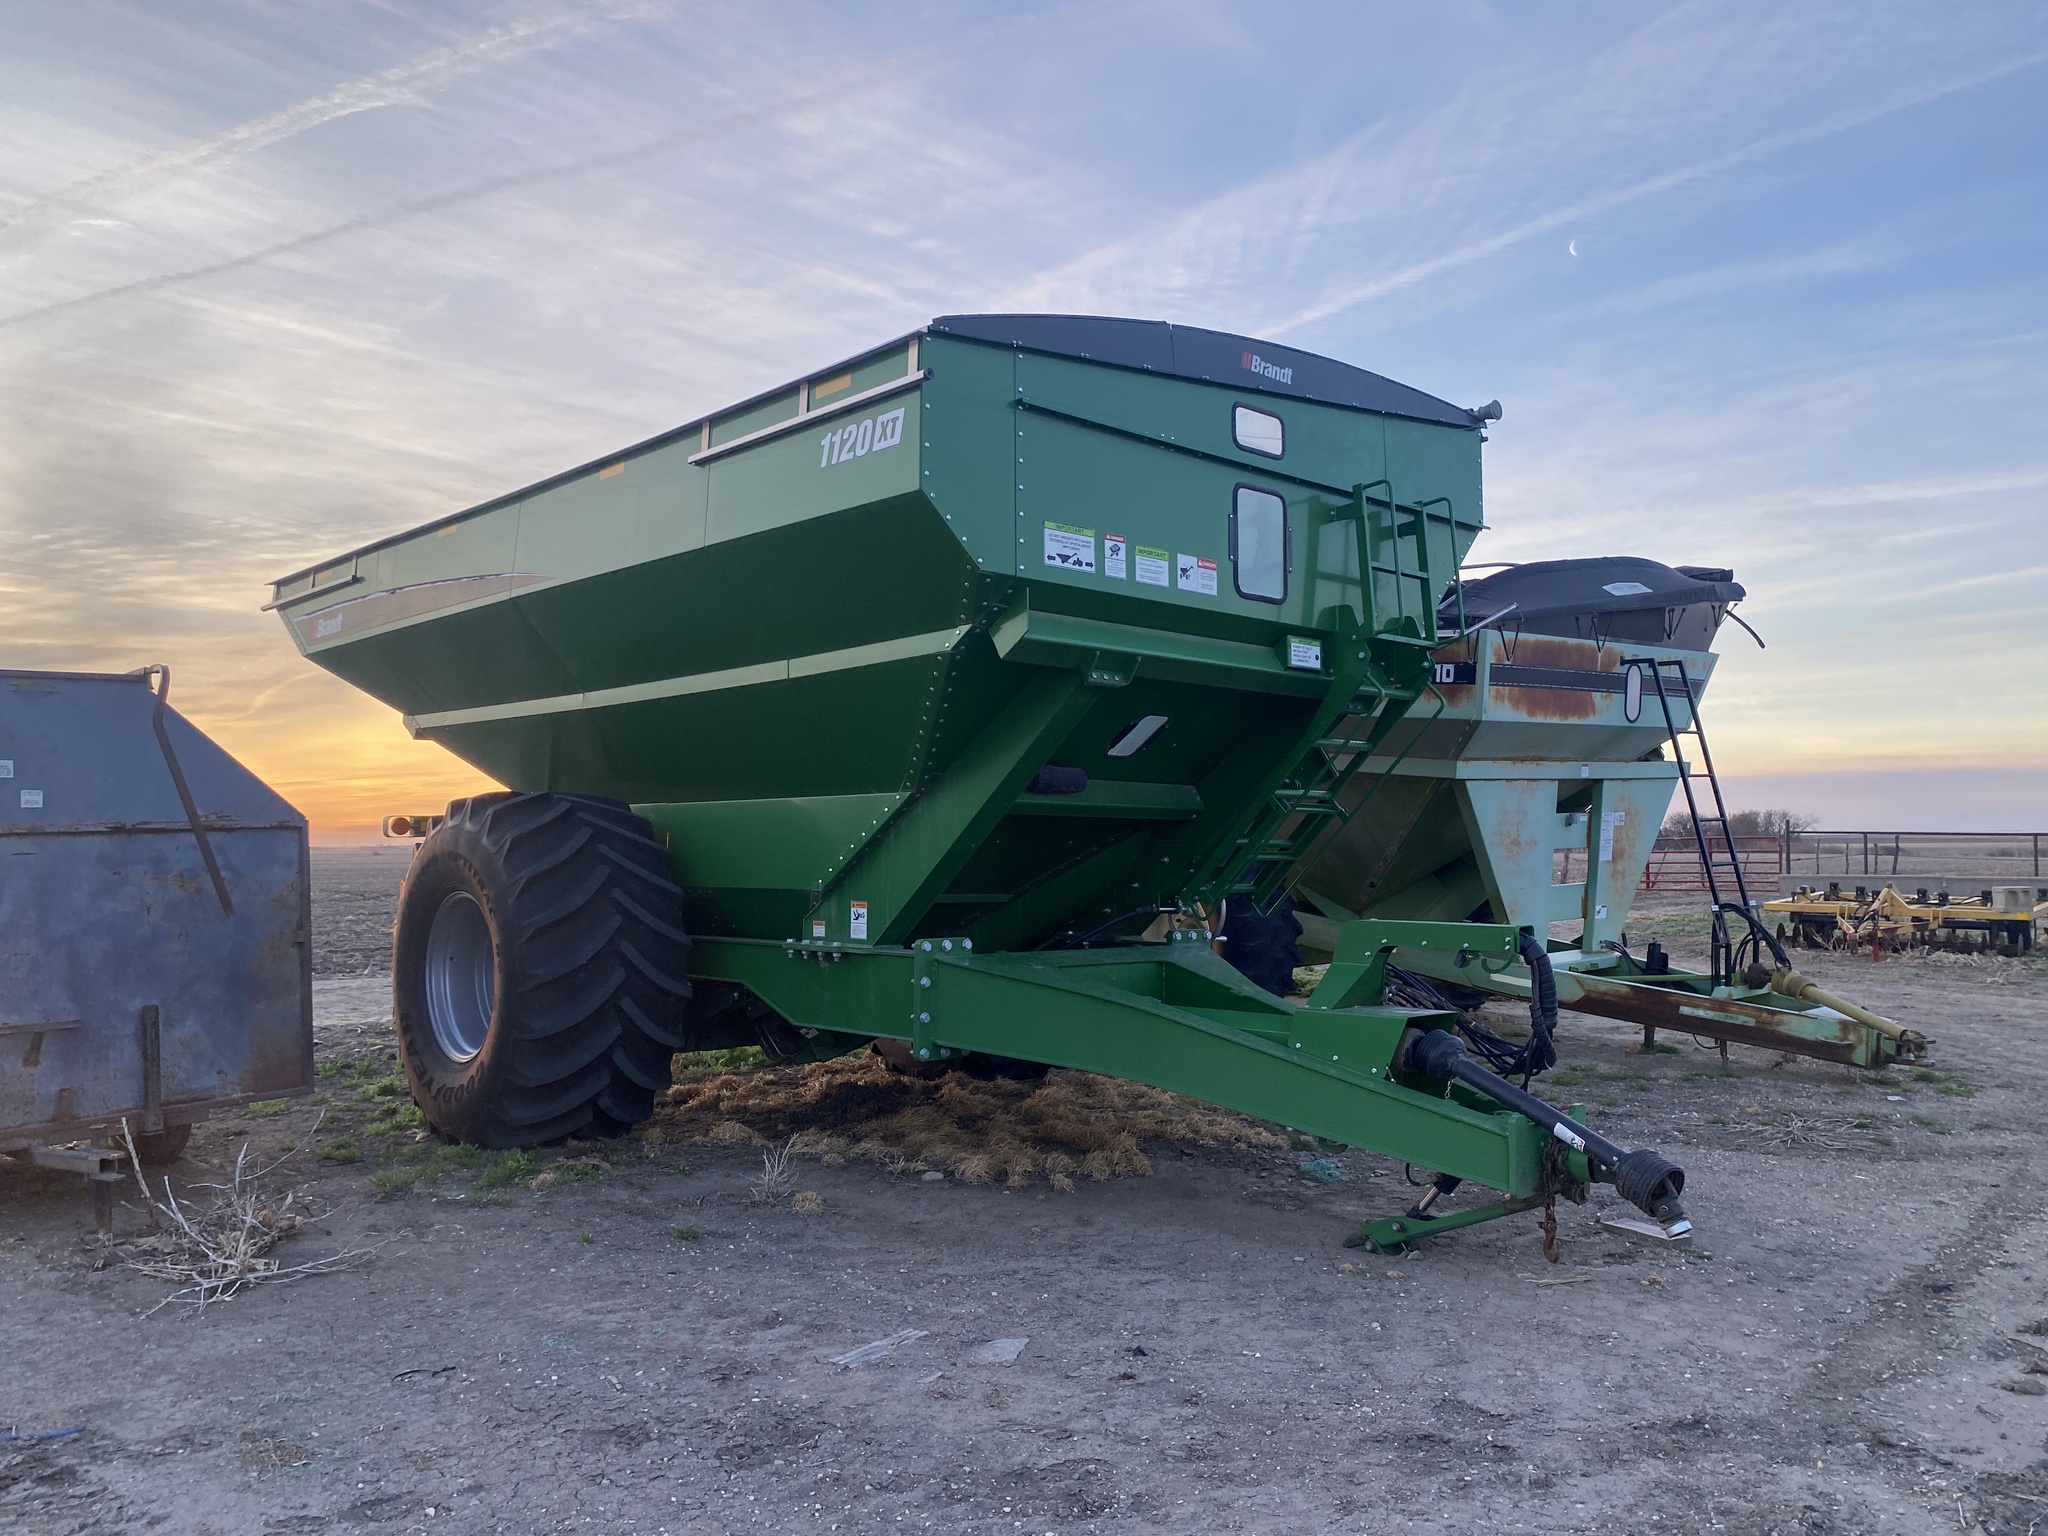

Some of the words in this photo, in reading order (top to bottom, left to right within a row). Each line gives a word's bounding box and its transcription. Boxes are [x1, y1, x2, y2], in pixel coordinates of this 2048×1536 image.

[1251, 354, 1293, 385] Brandt
[821, 419, 874, 468] 1120
[1056, 524, 1084, 534] IMPORTANT
[1137, 548, 1167, 559] IMPORTANT
[400, 1011, 485, 1101] GOODYEAR
